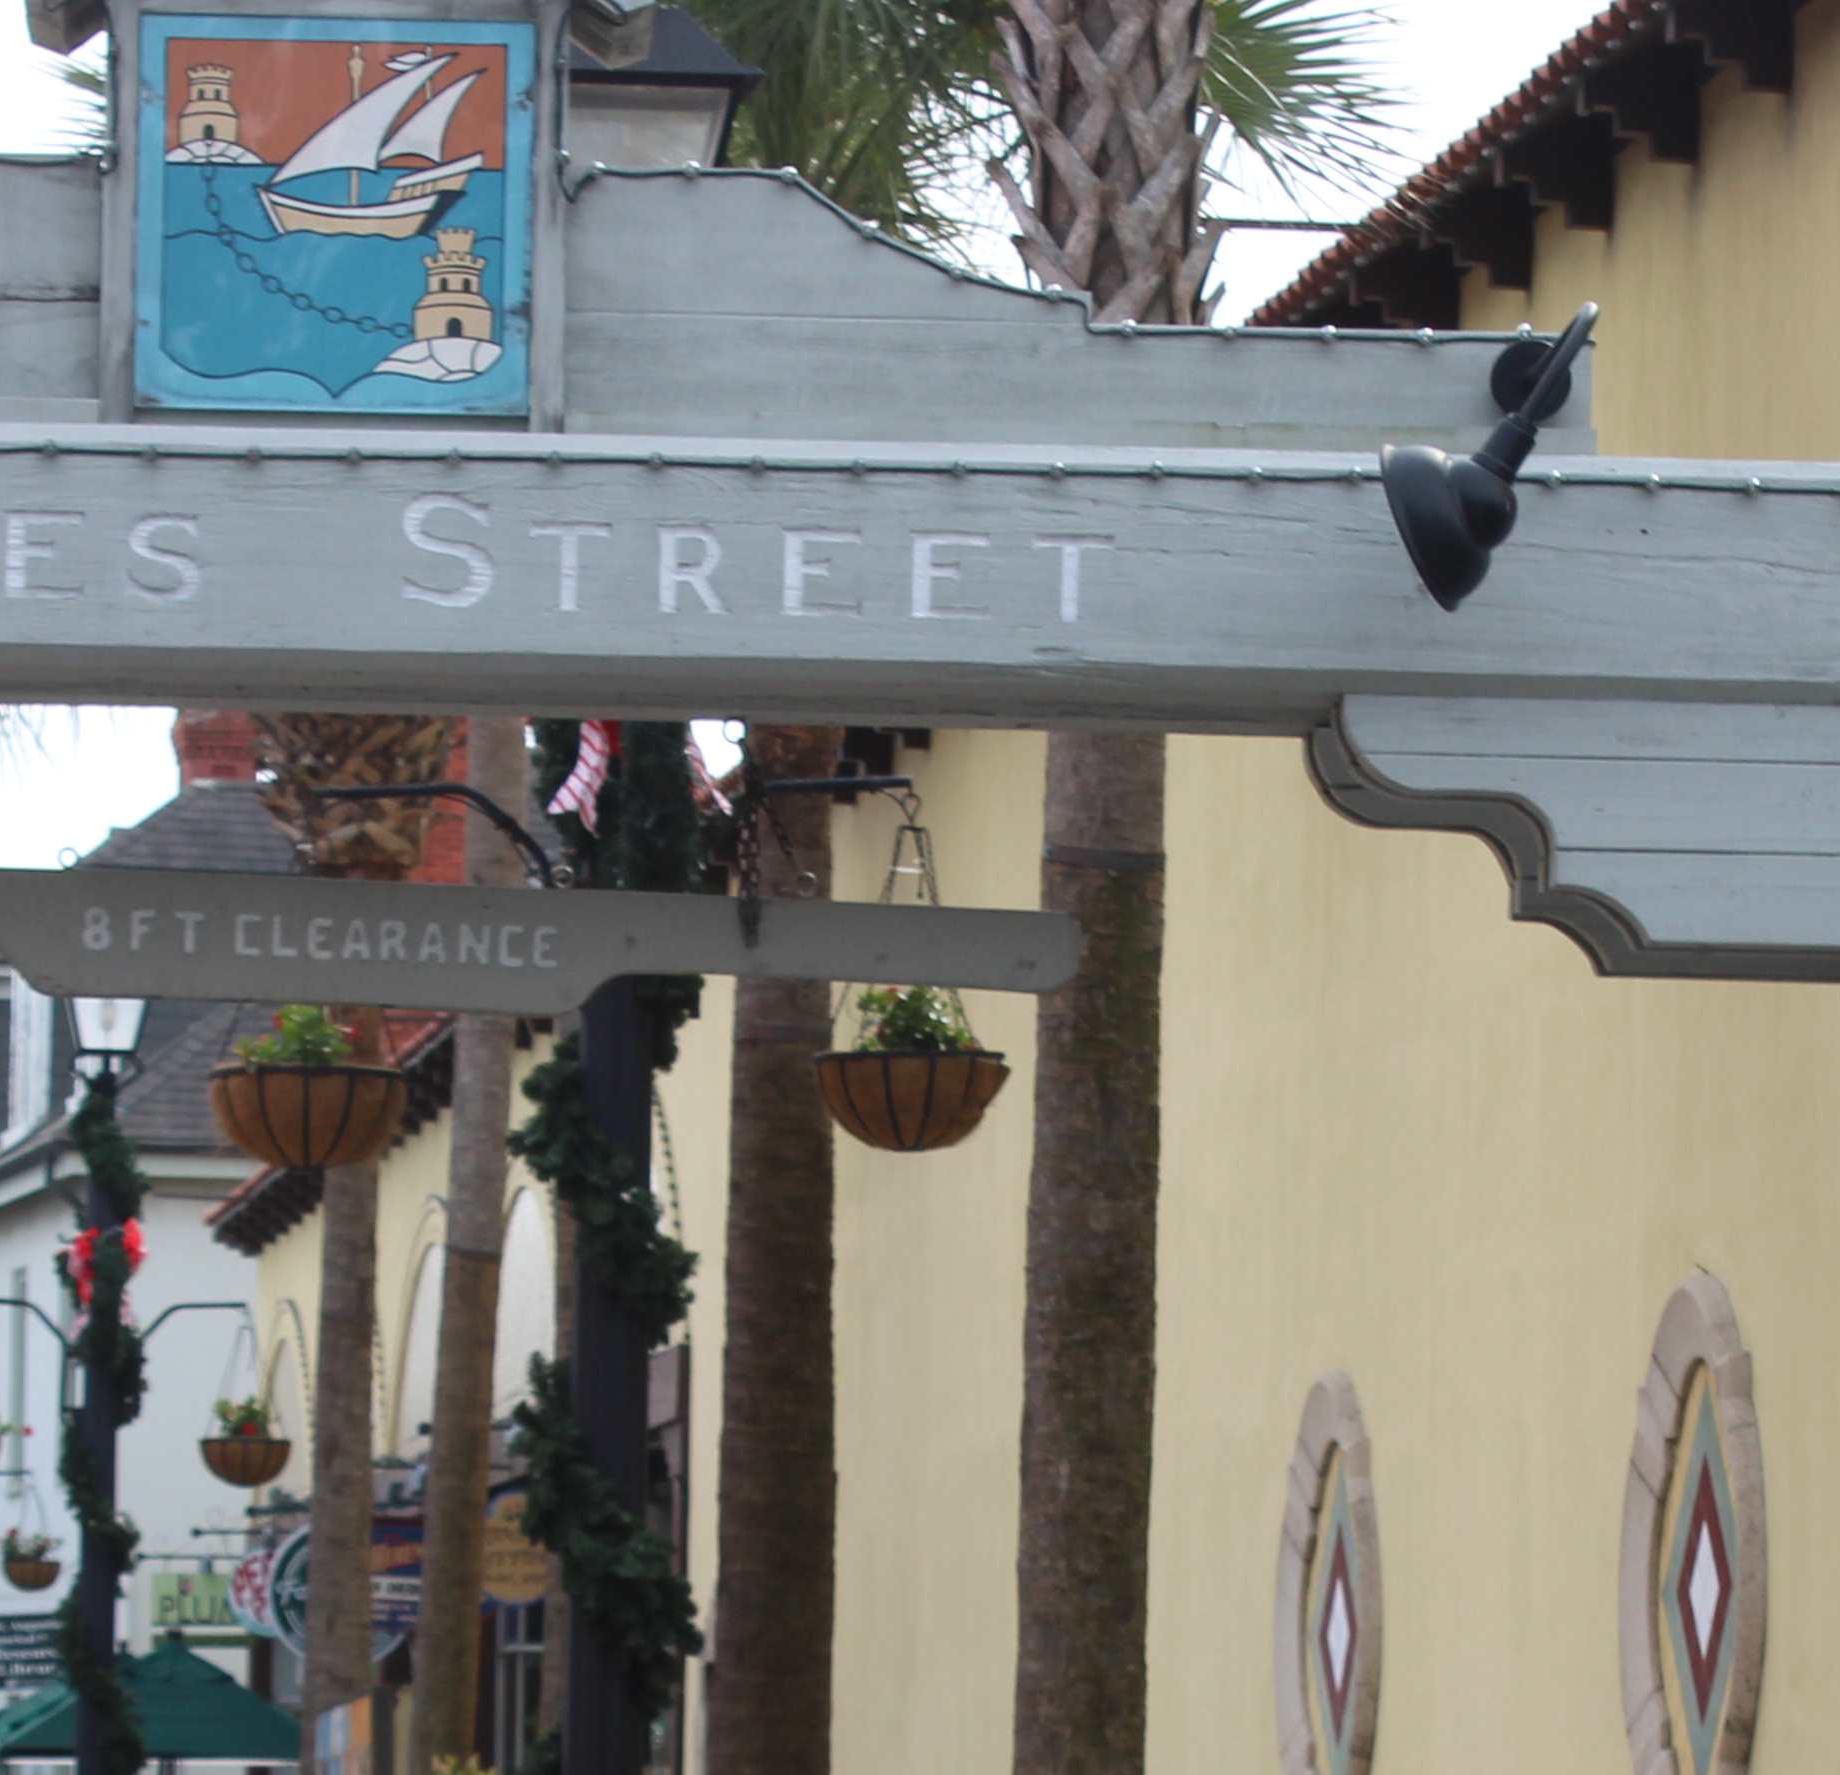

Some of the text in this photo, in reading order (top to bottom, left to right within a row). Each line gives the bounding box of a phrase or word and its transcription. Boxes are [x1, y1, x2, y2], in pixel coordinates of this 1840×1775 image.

[402, 492, 1115, 622] STREET
[81, 906, 112, 951] 8
[233, 913, 558, 968] CLEARANCE
